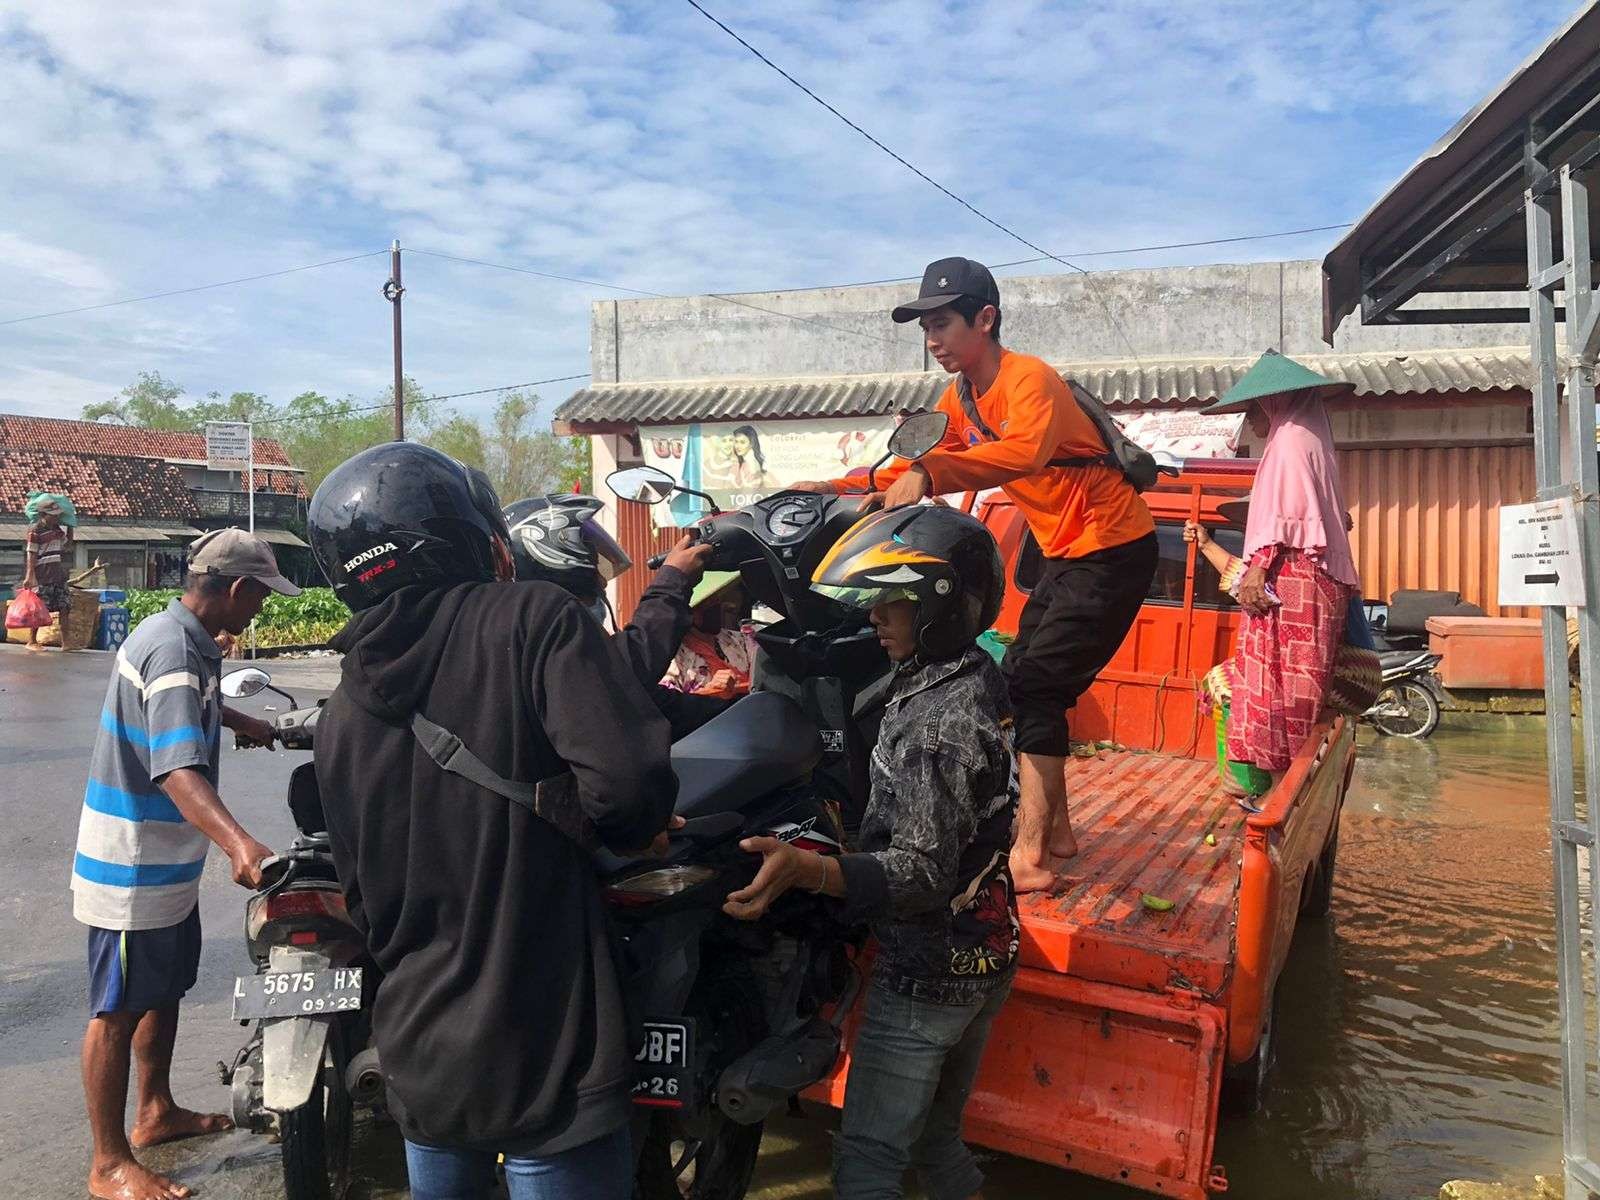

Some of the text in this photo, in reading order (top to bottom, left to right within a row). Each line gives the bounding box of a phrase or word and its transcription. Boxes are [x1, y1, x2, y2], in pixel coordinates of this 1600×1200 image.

[729, 493, 762, 507] TOKO
[343, 542, 399, 573] HONDA
[233, 969, 361, 998] L 5675 HX
